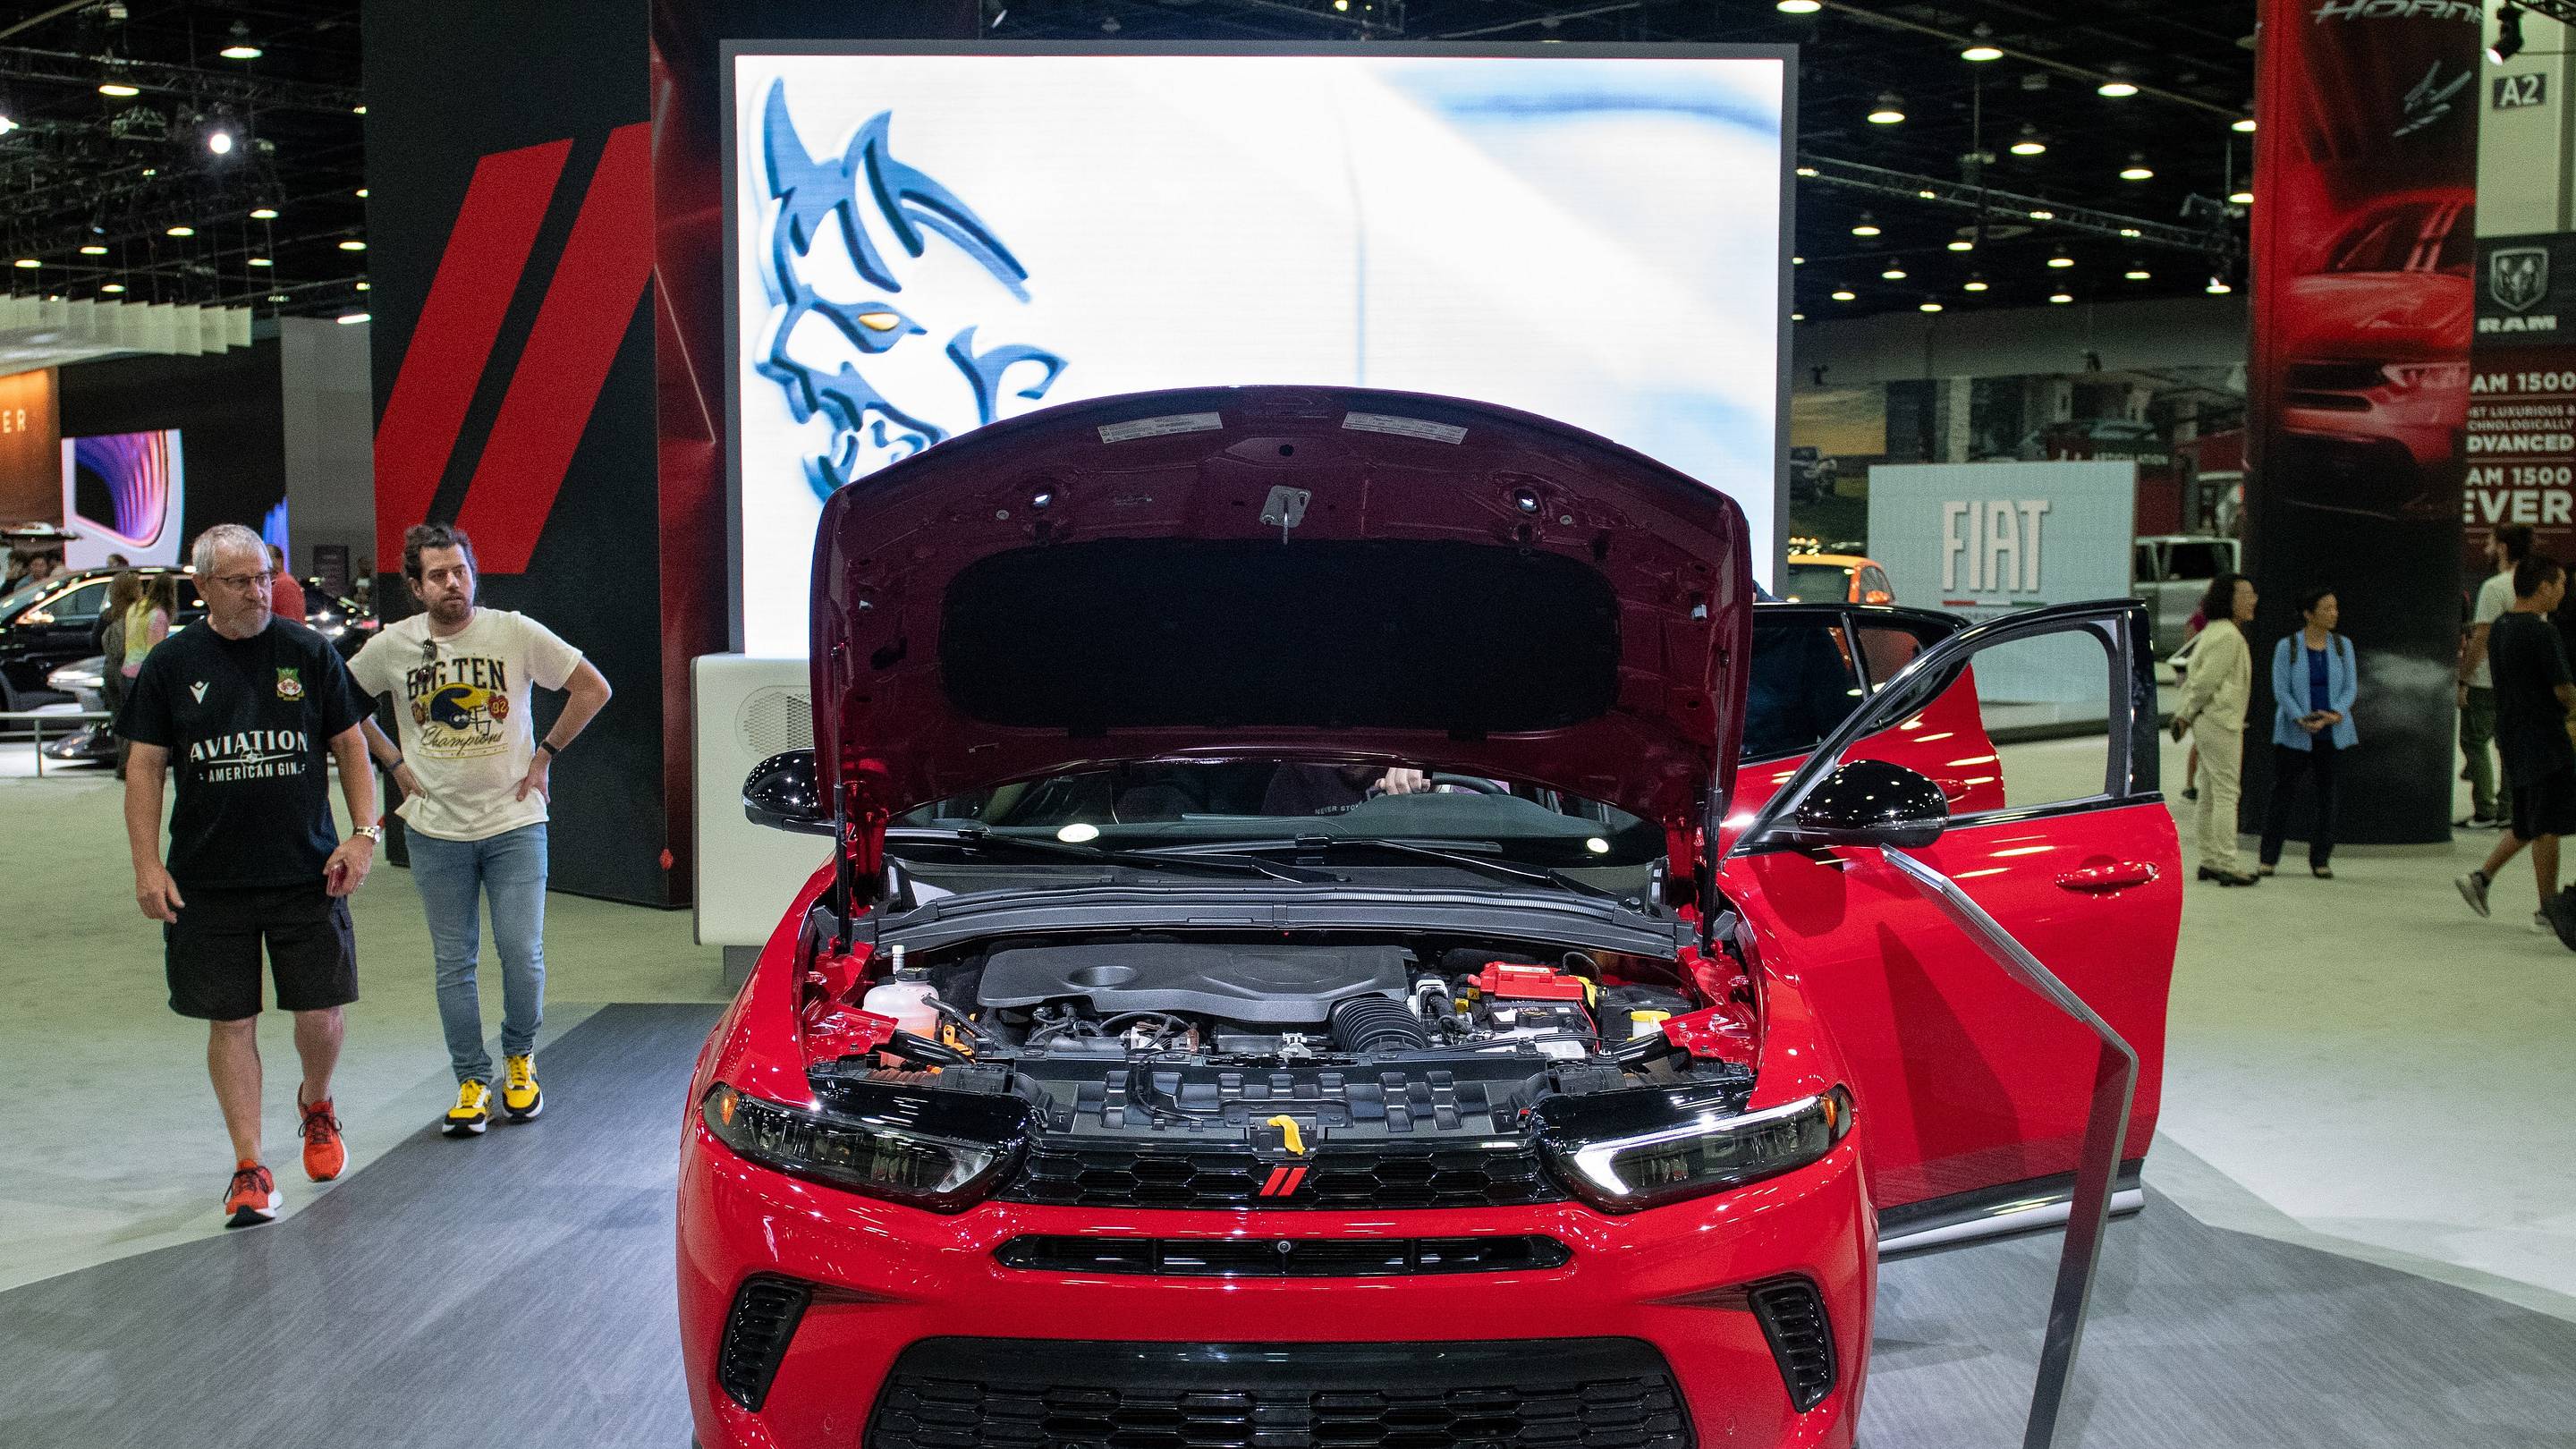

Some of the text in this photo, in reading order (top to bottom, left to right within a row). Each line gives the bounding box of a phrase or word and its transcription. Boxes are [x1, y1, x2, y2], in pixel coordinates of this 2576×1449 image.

[2499, 75, 2538, 107] A2
[2477, 315, 2557, 334] RAM
[2516, 371, 2576, 393] 1500
[2510, 465, 2572, 487] 1500
[1942, 499, 2050, 593] FIAT
[452, 657, 507, 692] TEN
[190, 730, 309, 763] AVIATION
[421, 726, 504, 756] Champions
[208, 763, 273, 784] AMERICAN
